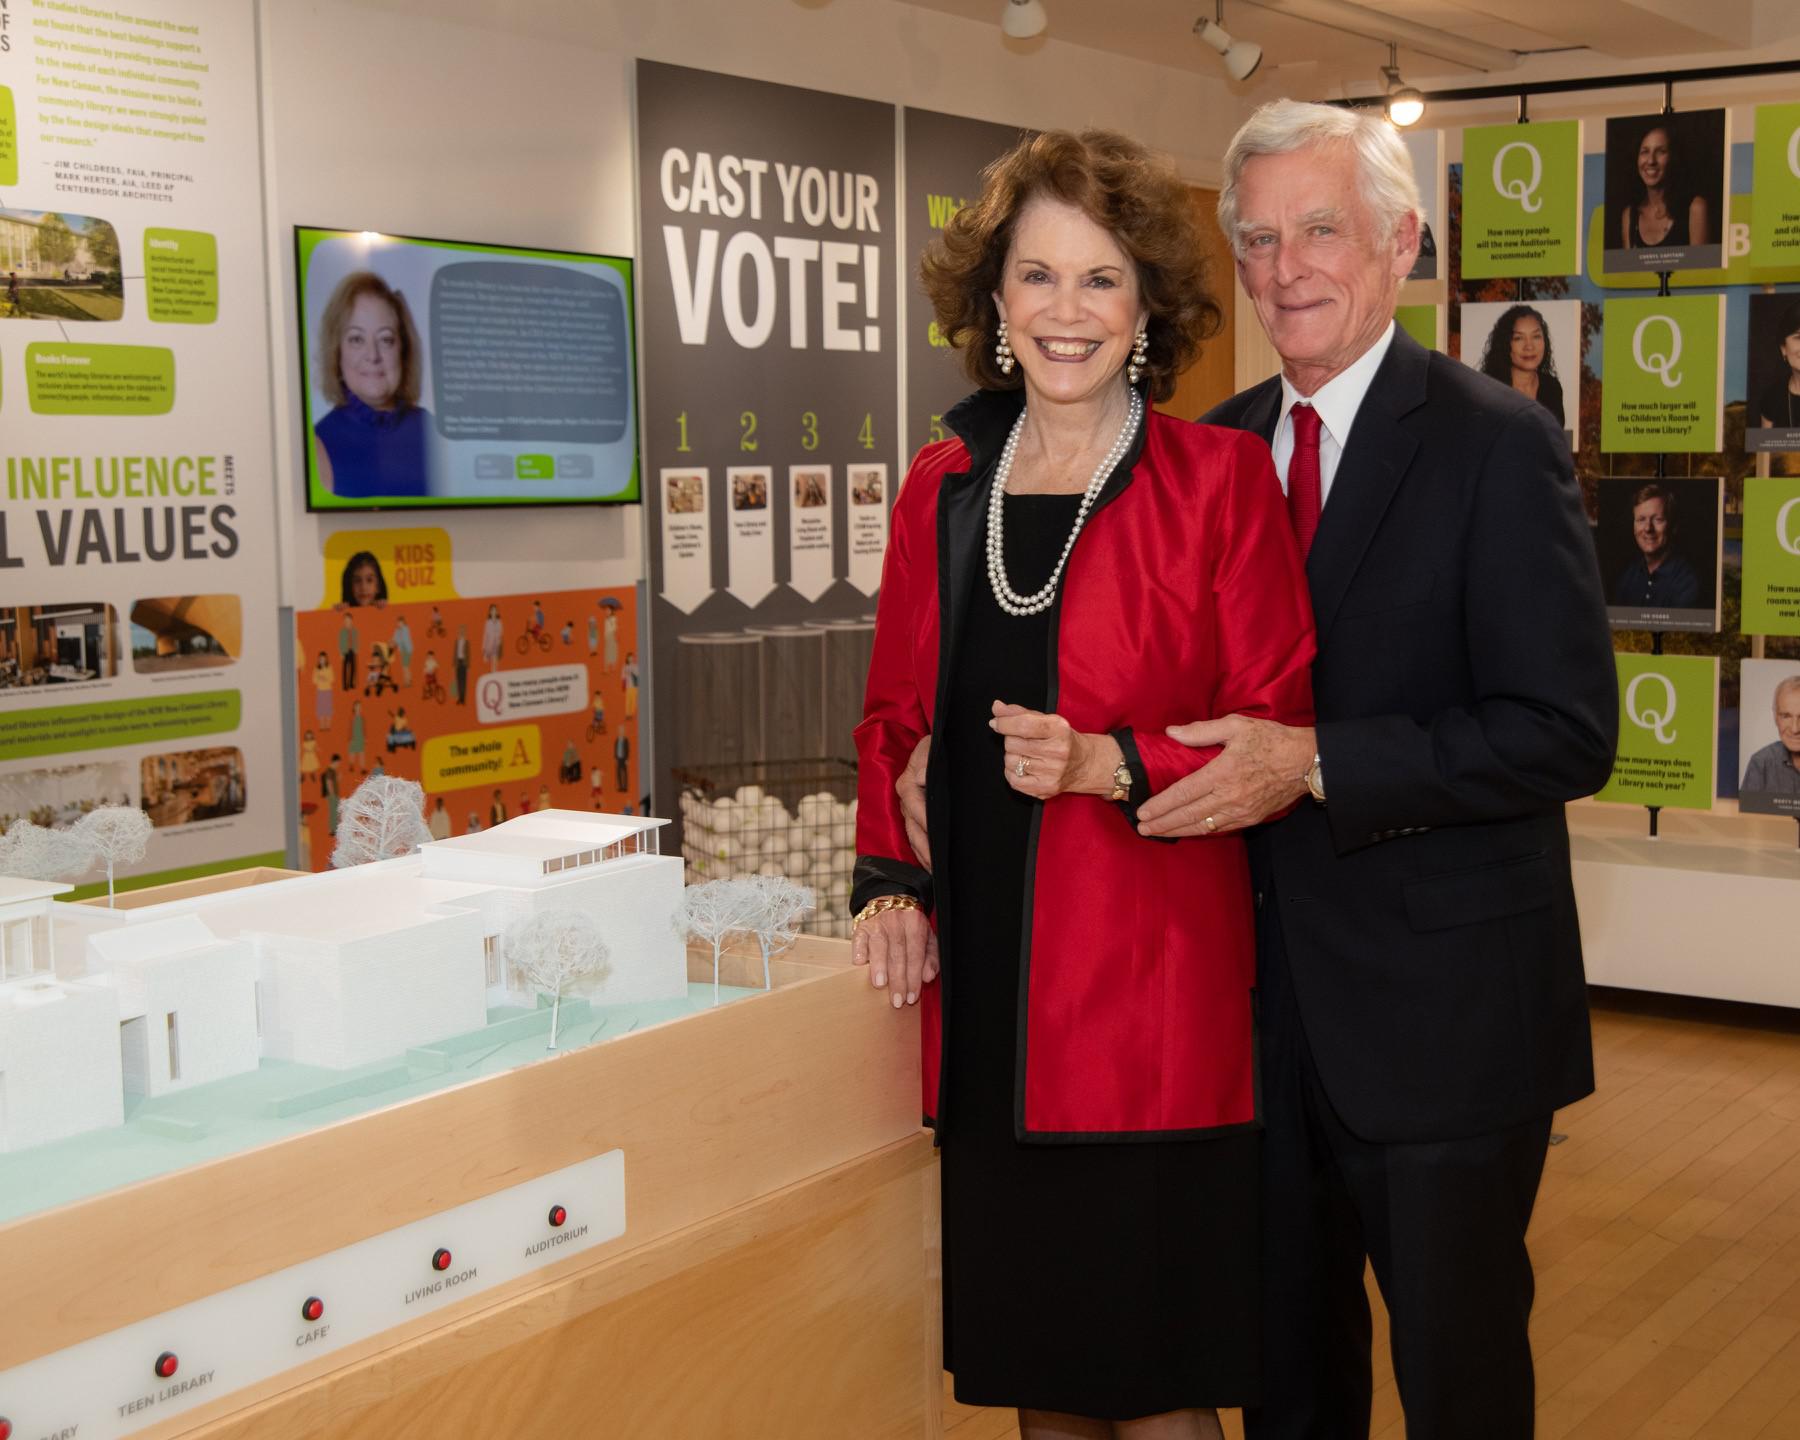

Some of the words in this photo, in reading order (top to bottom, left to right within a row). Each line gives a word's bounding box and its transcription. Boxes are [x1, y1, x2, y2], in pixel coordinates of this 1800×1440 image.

[0, 13, 10, 30] F
[80, 6, 113, 20] libraries
[115, 11, 134, 23] from
[135, 16, 162, 29] around
[163, 20, 177, 32] the
[178, 23, 199, 35] world
[32, 18, 49, 28] and
[51, 20, 76, 33] found
[77, 24, 94, 35] that
[95, 28, 109, 37] the
[110, 30, 128, 41] best
[129, 33, 164, 48] buildings
[165, 40, 195, 52] support
[34, 36, 69, 51] library's
[70, 42, 102, 55] mission
[103, 47, 113, 58] by
[114, 49, 152, 66] providing
[153, 57, 179, 69] spaces
[179, 59, 209, 73] tailored
[35, 55, 44, 65] to
[46, 57, 59, 67] the
[62, 61, 86, 72] needs
[88, 63, 96, 73] of
[97, 65, 116, 77] each
[118, 69, 157, 83] individual
[36, 73, 50, 84] For
[51, 76, 70, 88] New
[105, 84, 119, 96] the
[120, 87, 151, 101] mission
[152, 93, 167, 103] was
[168, 94, 176, 104] to
[177, 95, 197, 107] build
[38, 95, 84, 111] community
[116, 105, 127, 114] we
[128, 107, 147, 117] were
[148, 109, 179, 125] strongly
[181, 113, 207, 126] guided
[39, 112, 49, 124] by
[51, 113, 65, 124] the
[66, 115, 81, 126] five
[83, 119, 109, 132] design
[111, 122, 134, 135] ideals
[136, 126, 152, 137] that
[153, 129, 186, 142] emerged
[187, 131, 205, 143] from
[40, 134, 54, 143] our
[54, 159, 70, 169] JIM
[151, 171, 194, 183] PRINCIPAL
[55, 171, 80, 182] MARK
[142, 181, 162, 191] LEED
[164, 183, 174, 192] AP
[1493, 141, 1542, 213] Q
[55, 182, 120, 198] CENTERBROOK
[122, 190, 174, 203] ARCHITECTS
[661, 147, 769, 221] CAST
[774, 162, 881, 232] YOUR
[1774, 226, 1790, 234] and
[1782, 213, 1799, 221] How
[1477, 240, 1489, 248] will
[1491, 240, 1503, 248] the
[1520, 237, 1560, 246] Auditorium
[1487, 228, 1503, 237] How
[1504, 228, 1524, 238] many
[1525, 226, 1550, 237] people
[1490, 249, 1546, 260] accommodate?
[662, 224, 881, 352] VOTE!
[35, 353, 61, 365] Books
[1632, 315, 1682, 388] Q
[1617, 413, 1629, 422] the
[1630, 413, 1667, 423] Children's
[1668, 414, 1690, 422] Room
[1690, 413, 1700, 422] be
[1621, 401, 1637, 411] How
[1638, 401, 1658, 410] much
[1660, 401, 1681, 412] larger
[1683, 400, 1696, 409] will
[676, 411, 691, 451] 1
[740, 411, 758, 451] 2
[802, 411, 819, 450] 3
[858, 413, 875, 449] 4
[1624, 425, 1631, 434] in
[1633, 426, 1645, 434] the
[1662, 425, 1692, 437] Library?
[7, 455, 217, 500] INFLUENCE
[224, 455, 235, 496] MEETS
[0, 510, 24, 568] L
[36, 504, 239, 567] VALUES
[393, 544, 435, 565] KIDS
[395, 566, 435, 588] QUIZ
[1767, 584, 1785, 592] How
[508, 680, 520, 688] How
[521, 678, 538, 688] many
[483, 680, 502, 715] Q
[1626, 672, 1677, 744] Q
[450, 744, 469, 757] The
[471, 741, 502, 754] whole
[509, 738, 531, 767] A
[1632, 757, 1652, 767] many
[1653, 759, 1672, 768] ways
[1673, 759, 1691, 768] does
[439, 758, 503, 777] community!
[1624, 767, 1666, 779] community
[1682, 771, 1695, 779] the
[1618, 778, 1644, 789] Library
[1646, 779, 1663, 788] each
[1664, 782, 1686, 791] year?
[525, 1224, 589, 1258] AUDITORIUM
[404, 1277, 443, 1304] LIVING
[444, 1267, 478, 1296] ROOM
[118, 1394, 156, 1418] TEEN
[158, 1369, 216, 1406] LIBRARY
